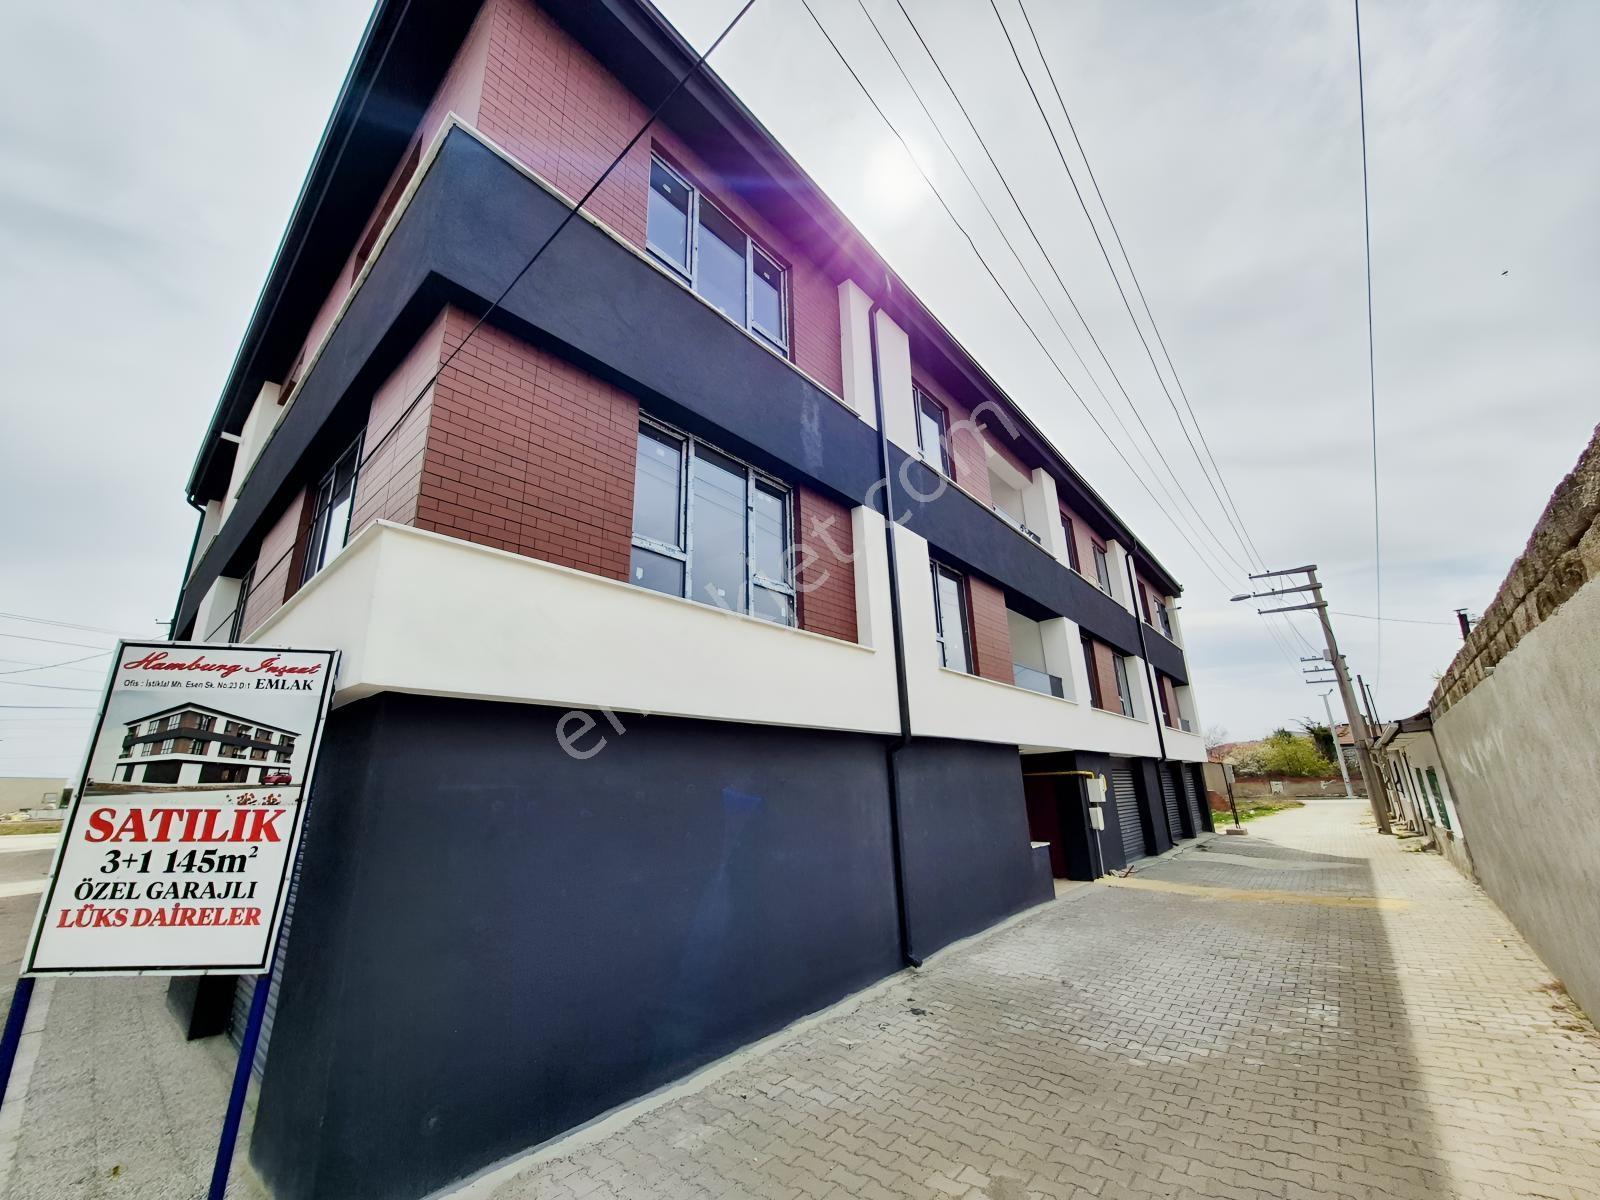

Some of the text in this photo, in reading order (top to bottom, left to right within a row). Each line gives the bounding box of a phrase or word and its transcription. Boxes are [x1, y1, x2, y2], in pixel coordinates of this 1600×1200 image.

[124, 652, 243, 678] Hamburg
[123, 679, 139, 687] Ofis
[254, 678, 314, 691] EMLAK
[84, 807, 287, 843] SATILIK
[100, 850, 153, 873] 3+1
[74, 878, 258, 900] ÖZEL GARAJLI
[56, 902, 262, 928] LÜKS DAİRELER
